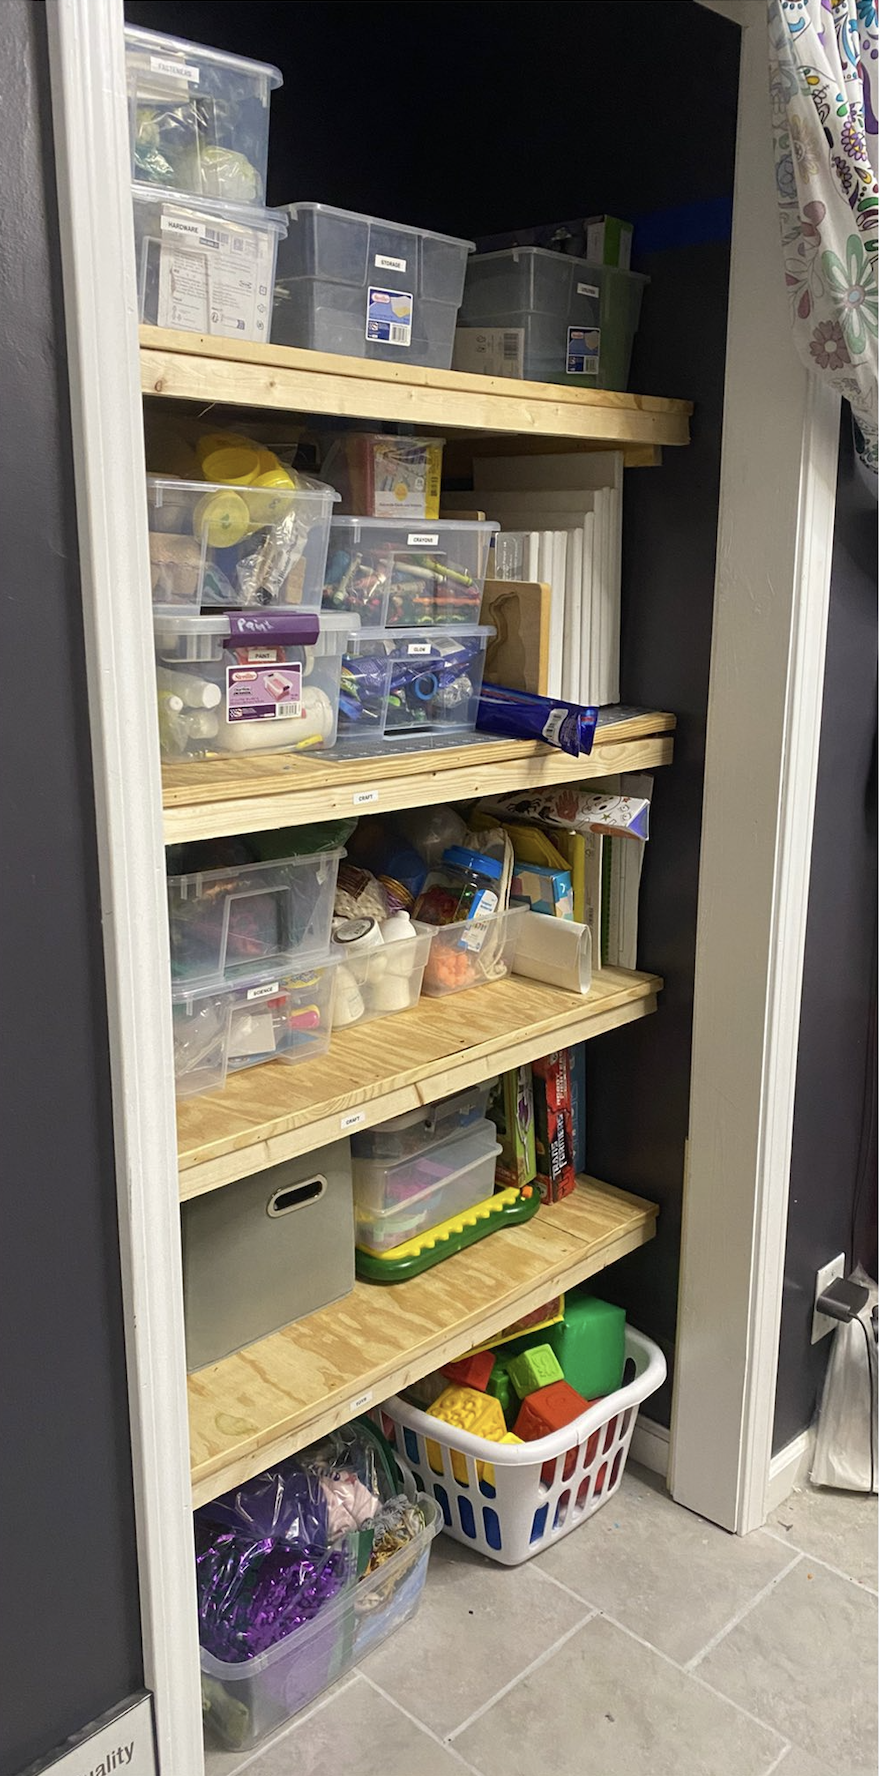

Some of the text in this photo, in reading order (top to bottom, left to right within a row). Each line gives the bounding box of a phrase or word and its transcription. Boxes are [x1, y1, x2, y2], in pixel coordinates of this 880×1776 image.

[167, 221, 199, 234] HARDWARE
[381, 259, 401, 267] STORAGE
[358, 793, 373, 801] CRAFT
[253, 986, 273, 996] SCIENCE
[345, 1115, 360, 1125] CRAFT
[557, 1113, 568, 1169] FORMERS
[551, 1140, 561, 1181] TRANS
